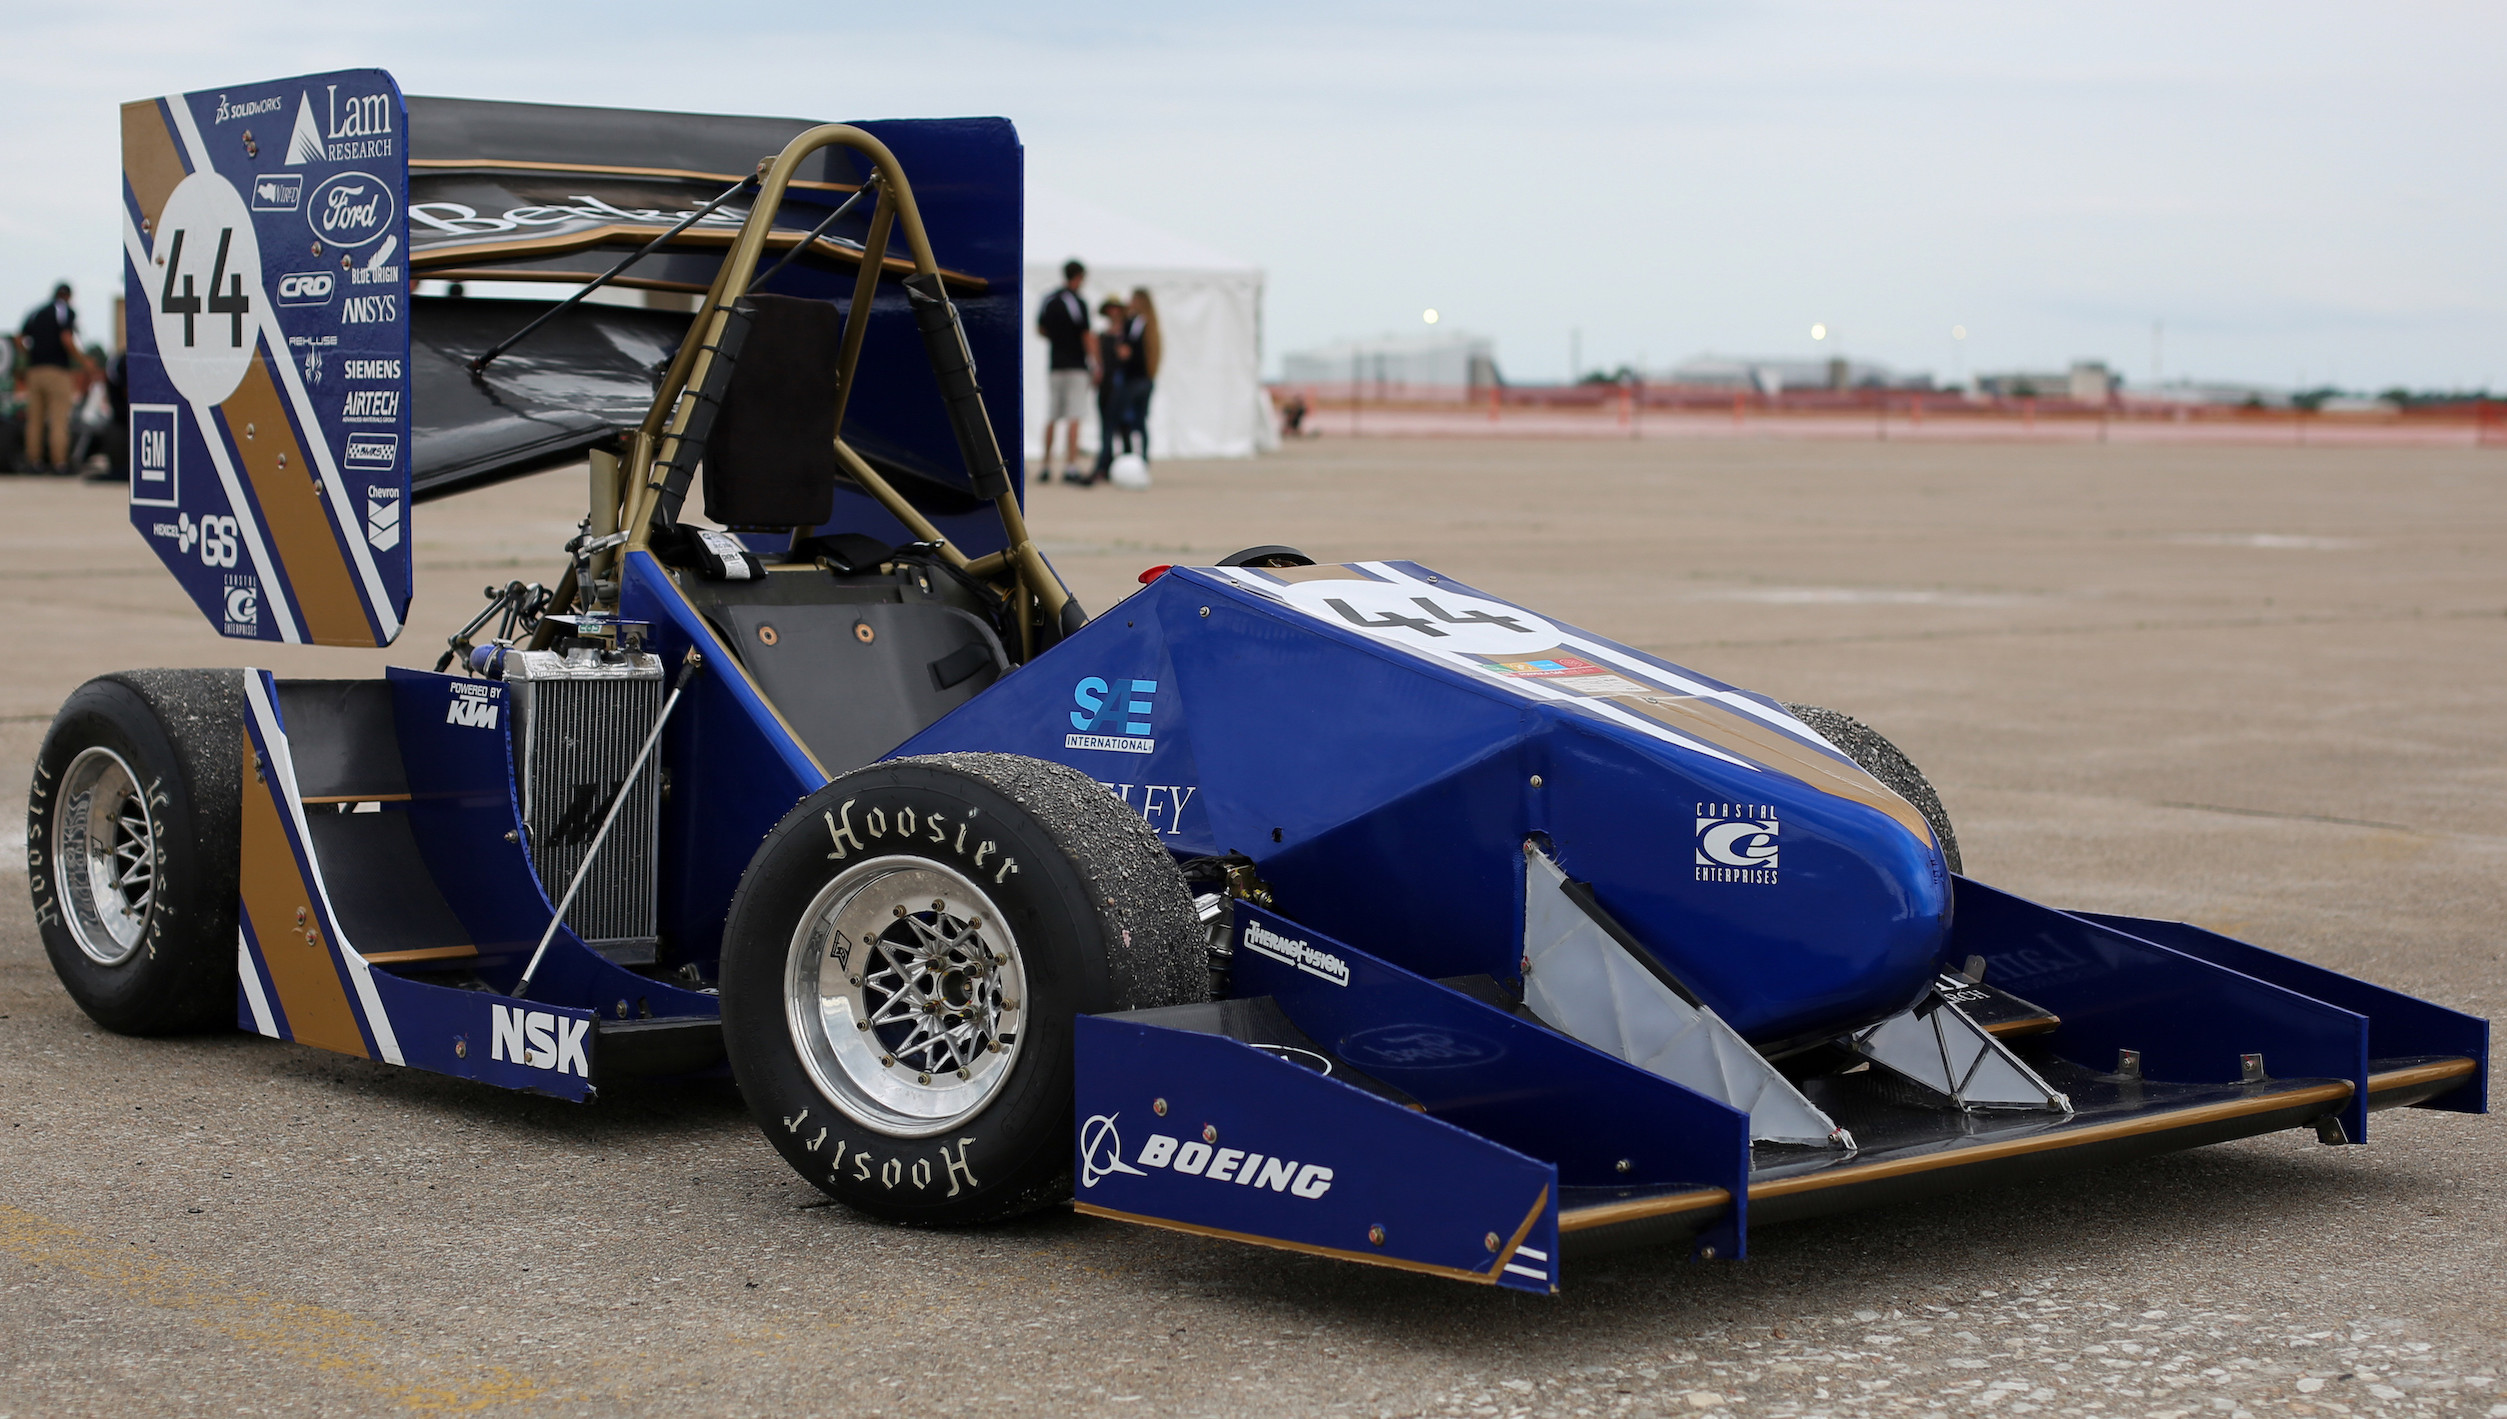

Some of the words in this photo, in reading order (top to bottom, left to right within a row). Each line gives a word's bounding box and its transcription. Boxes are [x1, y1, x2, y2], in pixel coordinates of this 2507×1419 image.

[231, 95, 282, 120] SOLIDWORKS
[327, 84, 392, 139] Lam
[328, 138, 392, 162] RESEARCH
[323, 185, 379, 232] Ford
[161, 227, 249, 347] 44
[280, 275, 332, 298] CRD
[351, 266, 370, 285] BLUE
[372, 265, 399, 284] ORIGIN
[341, 294, 396, 324] ANSYS
[344, 359, 401, 379] SIEMENS
[342, 390, 400, 416] AIRTECH
[141, 430, 166, 468] GM
[368, 484, 399, 499] Chevron
[153, 522, 180, 539] HEXCEL
[200, 514, 238, 569] GS
[1322, 596, 1537, 637] 44
[450, 682, 489, 698] POWERED
[489, 687, 502, 699] BY
[1069, 676, 1158, 736] SAE
[446, 694, 499, 731] KTM
[1696, 801, 1778, 820] COASTAL
[823, 798, 1018, 884] Hoosier
[1695, 866, 1778, 885] ENTERPRISES
[491, 1003, 590, 1079] NSK
[783, 1107, 980, 1198] Hoosier
[1137, 1133, 1333, 1200] BOEING
